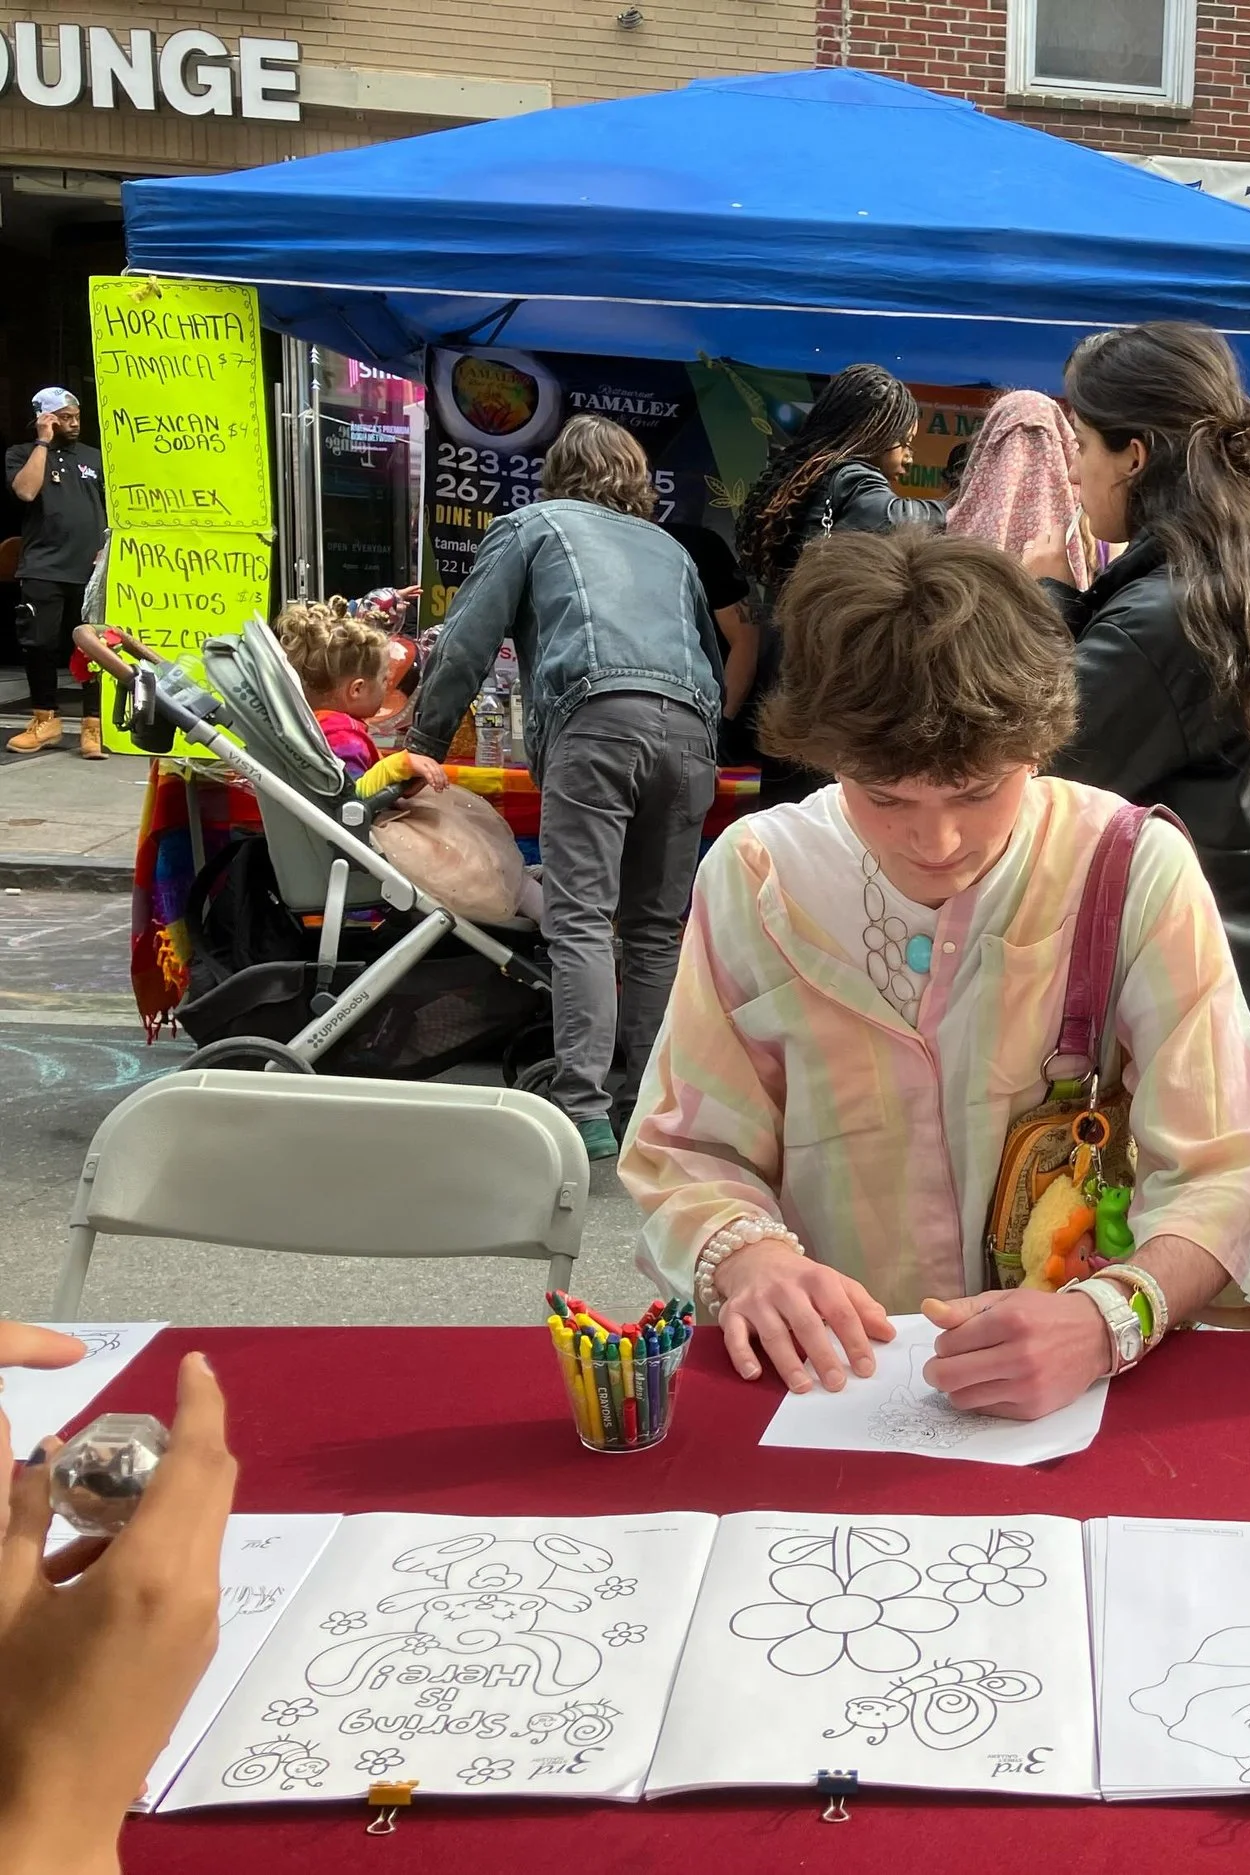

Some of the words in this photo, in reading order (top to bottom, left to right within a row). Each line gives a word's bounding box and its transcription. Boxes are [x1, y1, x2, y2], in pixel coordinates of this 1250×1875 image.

[0, 21, 300, 122] UNGE
[104, 304, 245, 343] HORCHATA
[101, 350, 216, 385] JAMAICA
[569, 391, 681, 418] TAMALEX
[112, 407, 220, 443] MEXICAN
[153, 432, 226, 454] SODAS
[119, 483, 232, 515] TAMALEX
[435, 504, 472, 527] DINE
[120, 537, 269, 582] MARGARITAS
[327, 542, 349, 552] OPEN
[351, 543, 392, 554] EVERYDAY
[434, 558, 458, 573] 122
[116, 582, 226, 622] MOJITOS
[228, 751, 262, 781] VISTA
[597, 1387, 613, 1428] CRAYONS
[368, 1664, 531, 1691] Here!
[414, 1687, 460, 1712] is
[339, 1708, 509, 1740] Spring
[528, 1747, 605, 1780] 3rd
[991, 1747, 1054, 1778] 3rd
